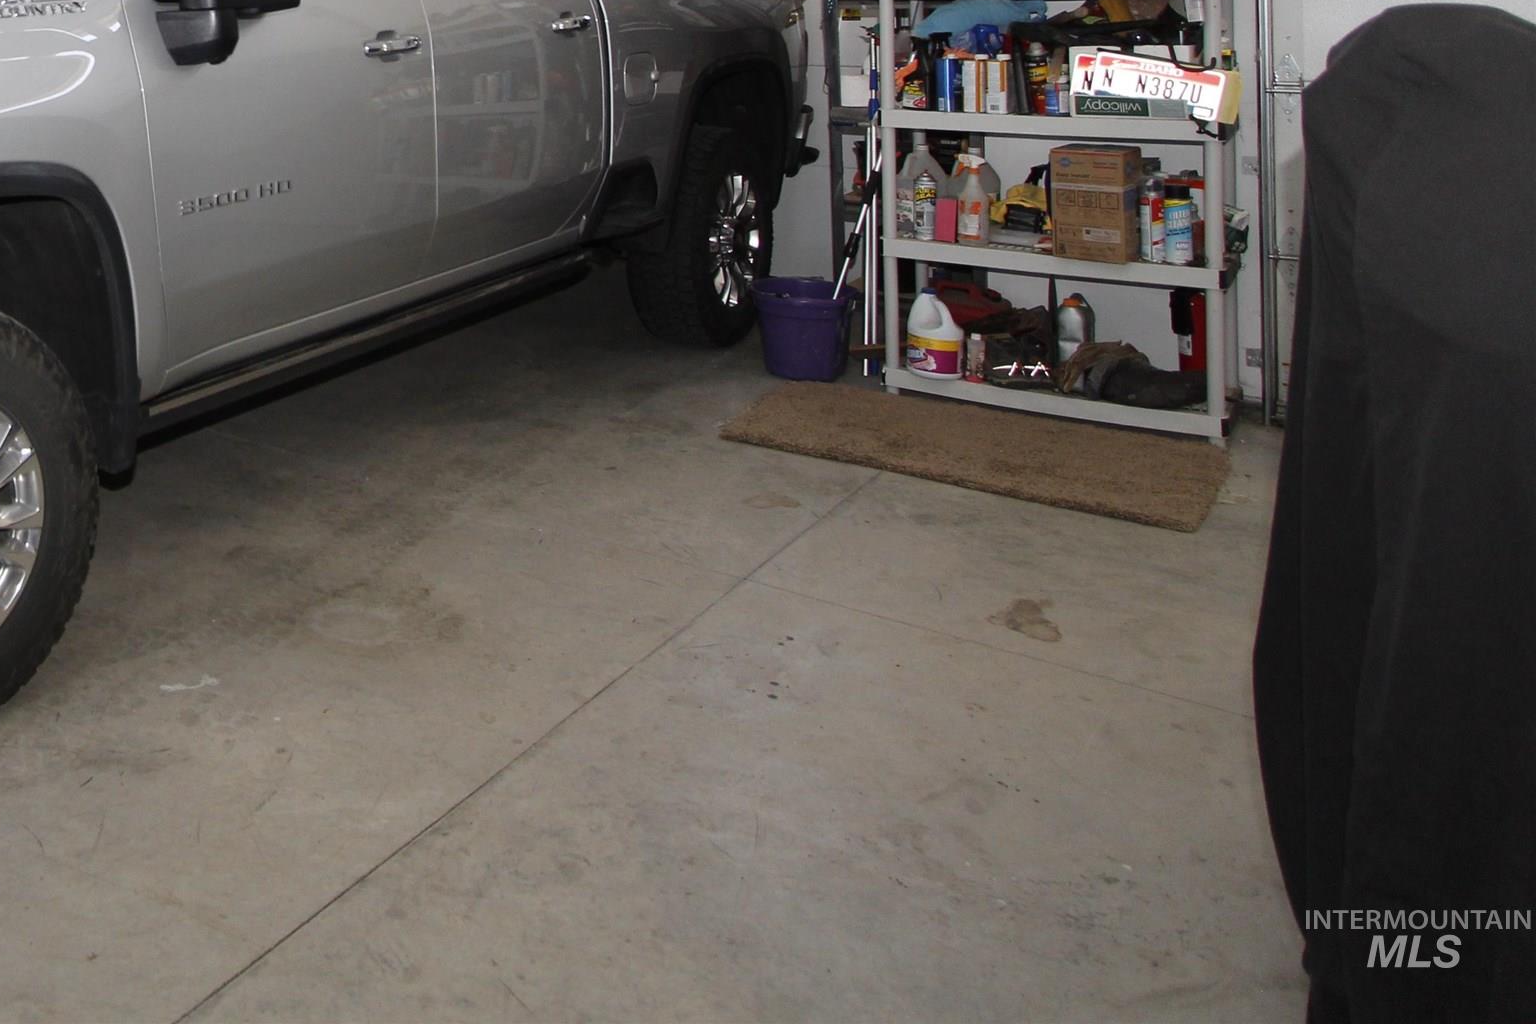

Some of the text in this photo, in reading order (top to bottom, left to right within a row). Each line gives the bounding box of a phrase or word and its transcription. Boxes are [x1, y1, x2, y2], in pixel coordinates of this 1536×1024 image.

[1135, 74, 1203, 104] N387U
[1081, 98, 1142, 113] willcopy
[178, 180, 291, 216] 3500 HD
